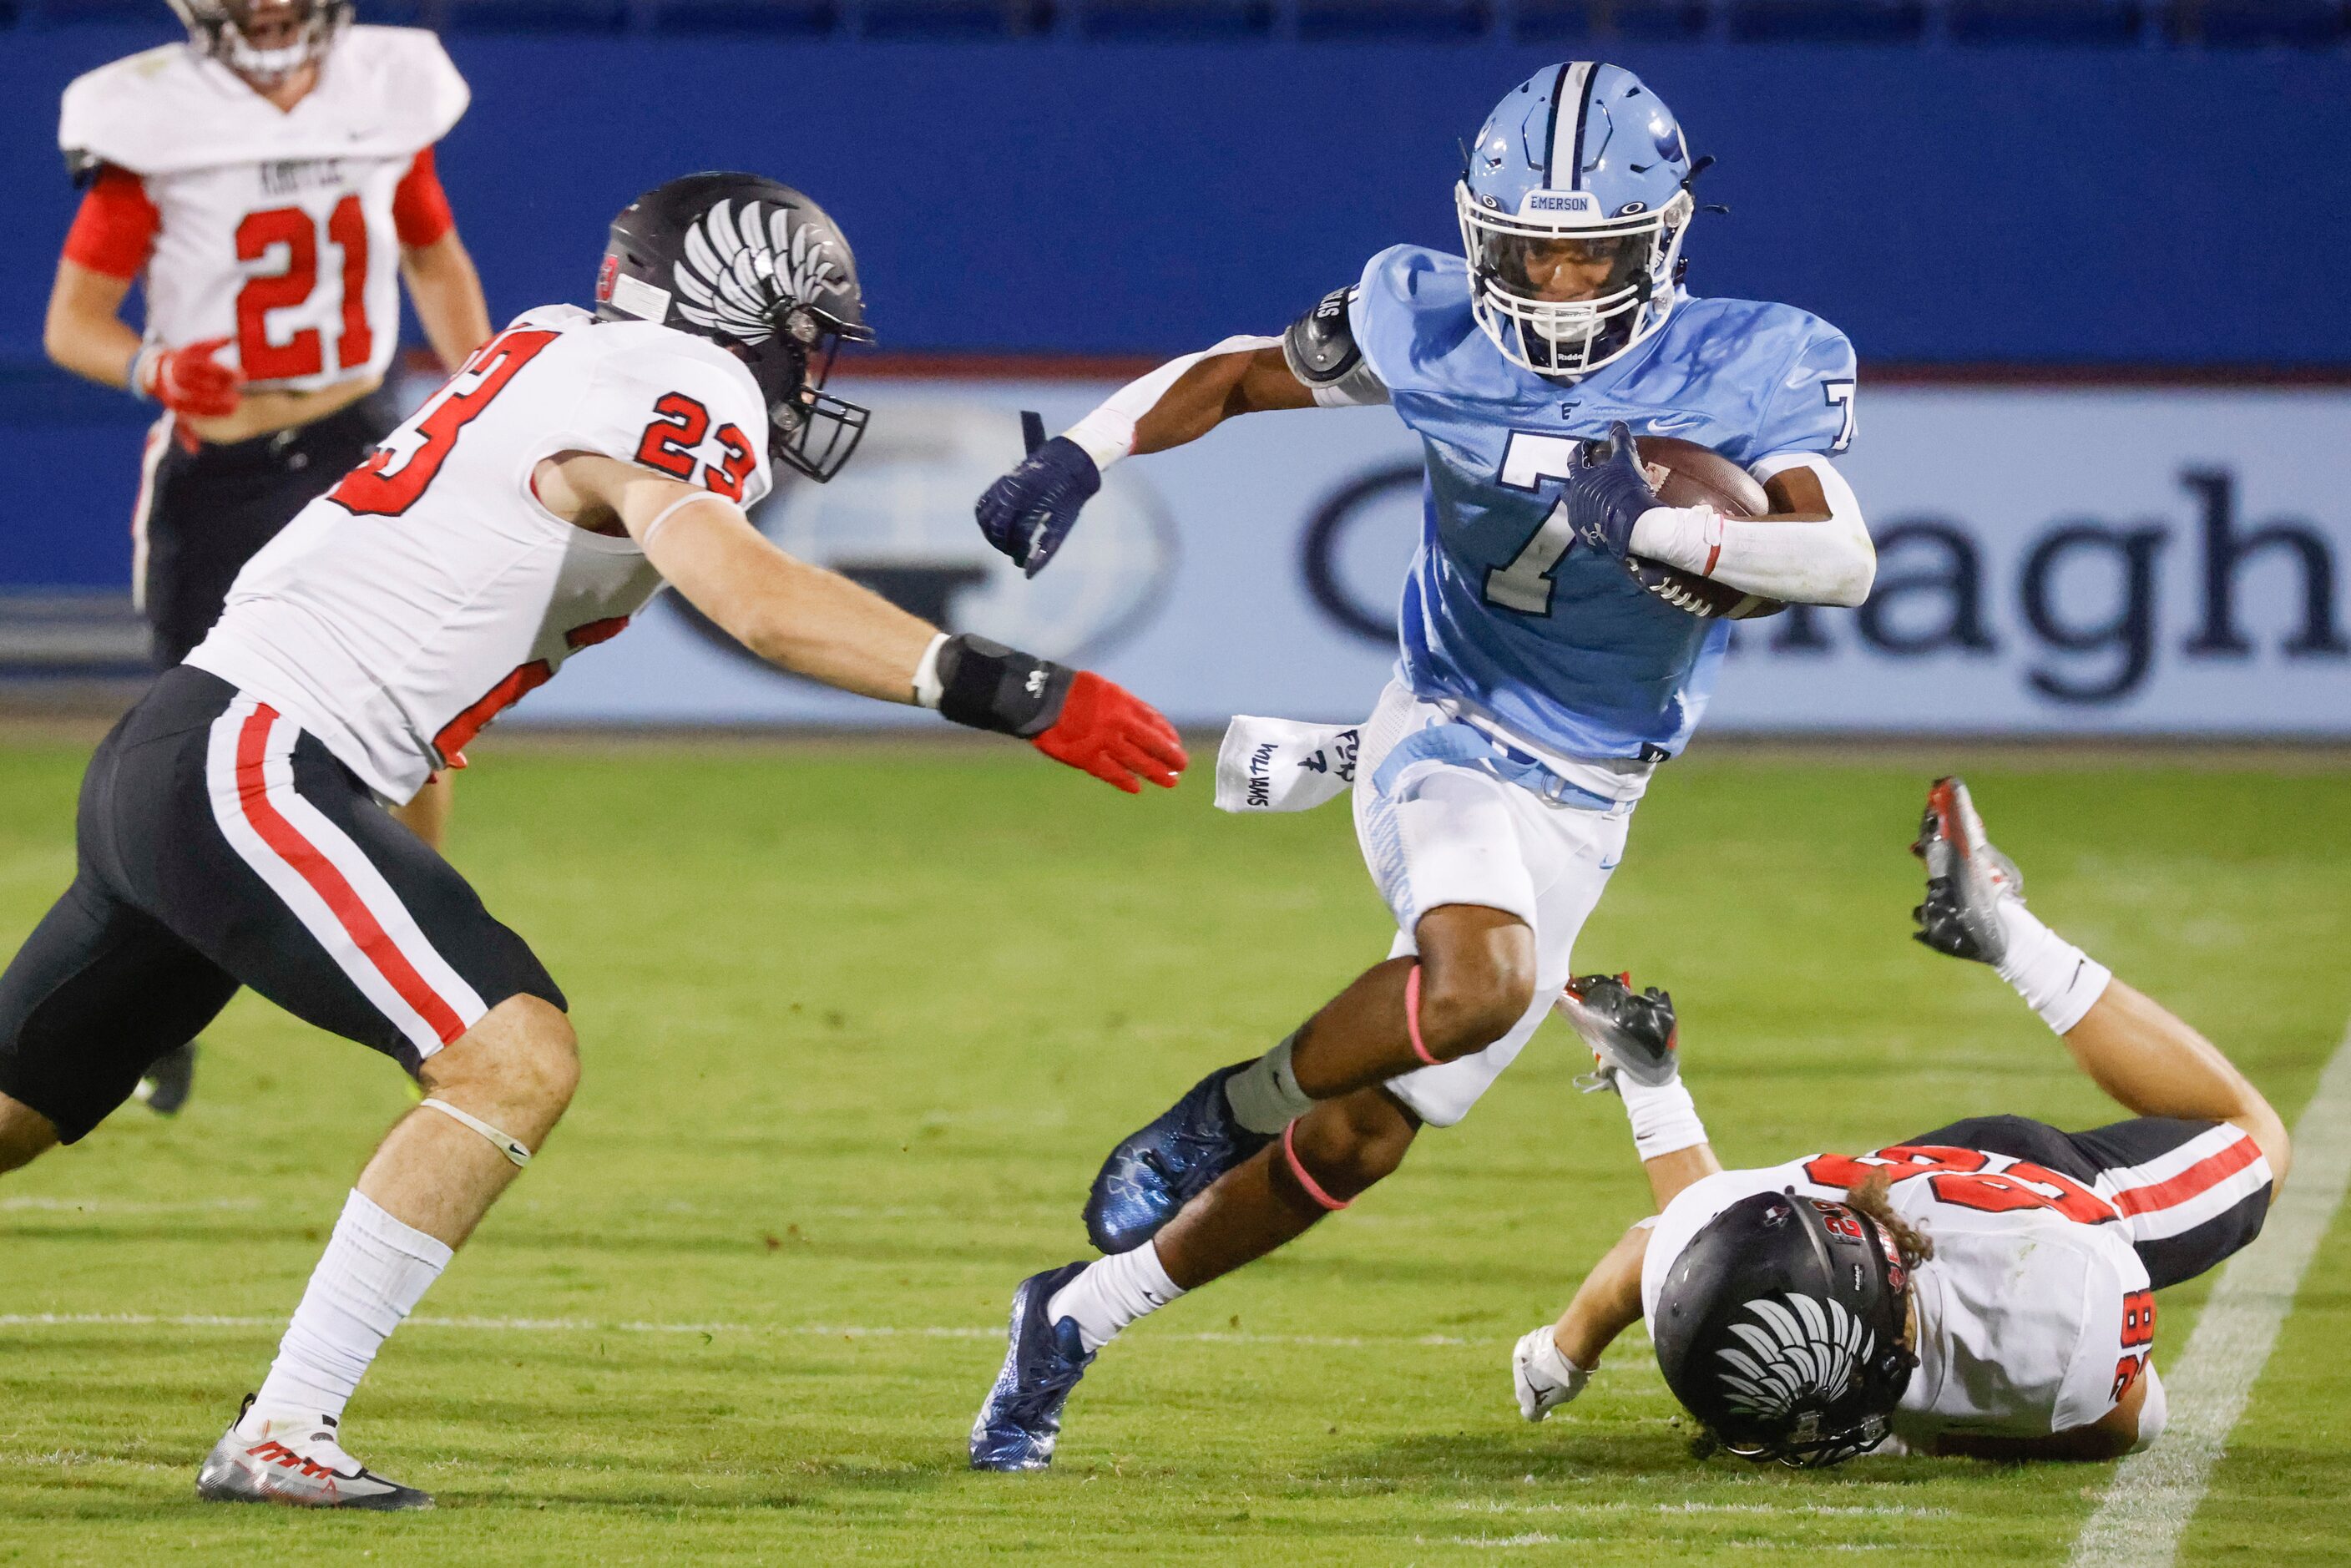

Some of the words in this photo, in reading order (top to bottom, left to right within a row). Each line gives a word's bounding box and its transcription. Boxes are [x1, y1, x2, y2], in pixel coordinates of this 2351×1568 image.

[1530, 195, 1588, 211] EMERSON
[235, 195, 372, 382] 21
[326, 321, 564, 517] 3
[634, 391, 756, 503] 23
[1821, 378, 1855, 453] 7
[1481, 429, 1585, 618] 7
[1246, 743, 1279, 807] WILLIAMS
[1297, 750, 1327, 773] 7
